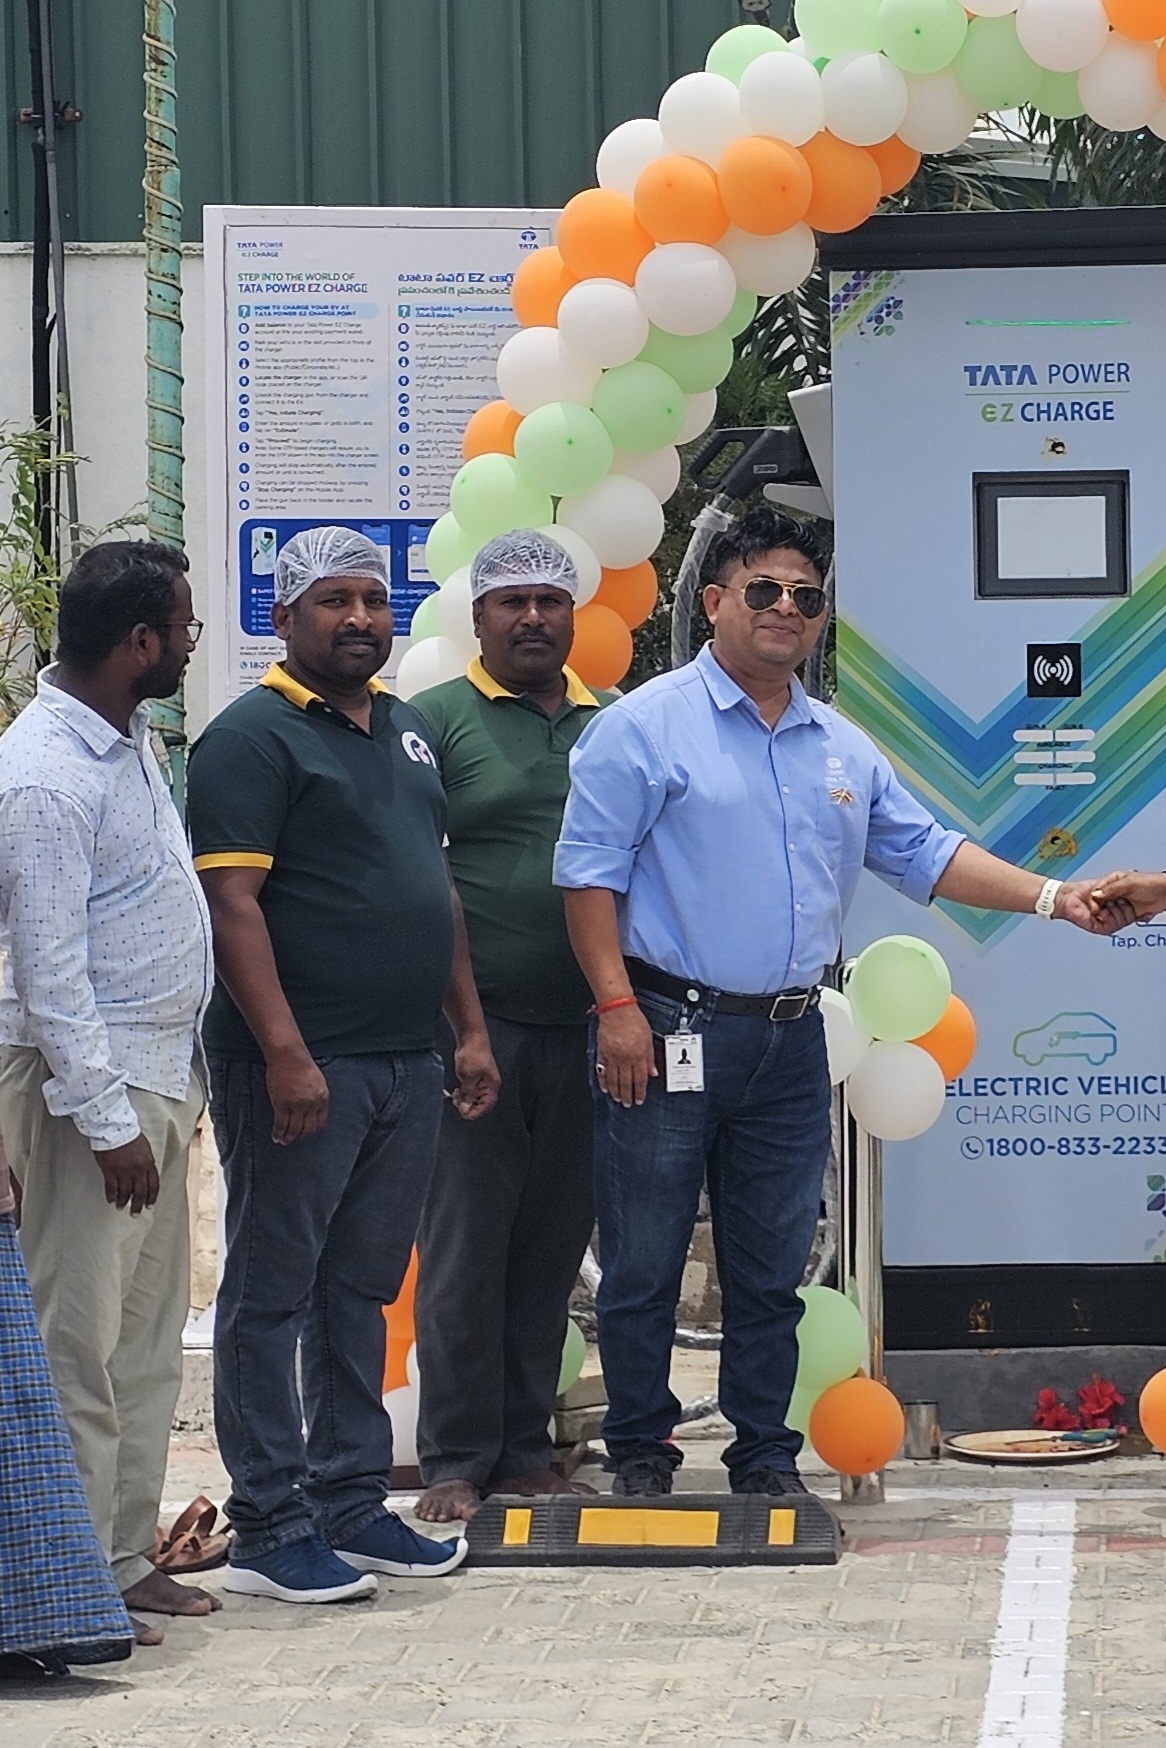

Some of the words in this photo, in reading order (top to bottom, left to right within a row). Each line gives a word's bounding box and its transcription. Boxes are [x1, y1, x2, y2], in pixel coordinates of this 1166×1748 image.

[238, 273, 260, 281] STEP
[261, 273, 283, 281] INTO
[285, 273, 303, 281] THE
[305, 273, 340, 281] WORLD
[342, 273, 355, 281] OF
[468, 273, 485, 283] EZ
[238, 283, 263, 293] TATA
[266, 283, 306, 293] POWER
[308, 283, 321, 293] EZ
[323, 283, 368, 293] CHARGE
[963, 364, 1038, 386] TATA
[1048, 363, 1131, 384] POWER
[1020, 401, 1115, 423] CHARGE
[1110, 935, 1141, 949] Tap.
[955, 1104, 1091, 1125] CHARGING
